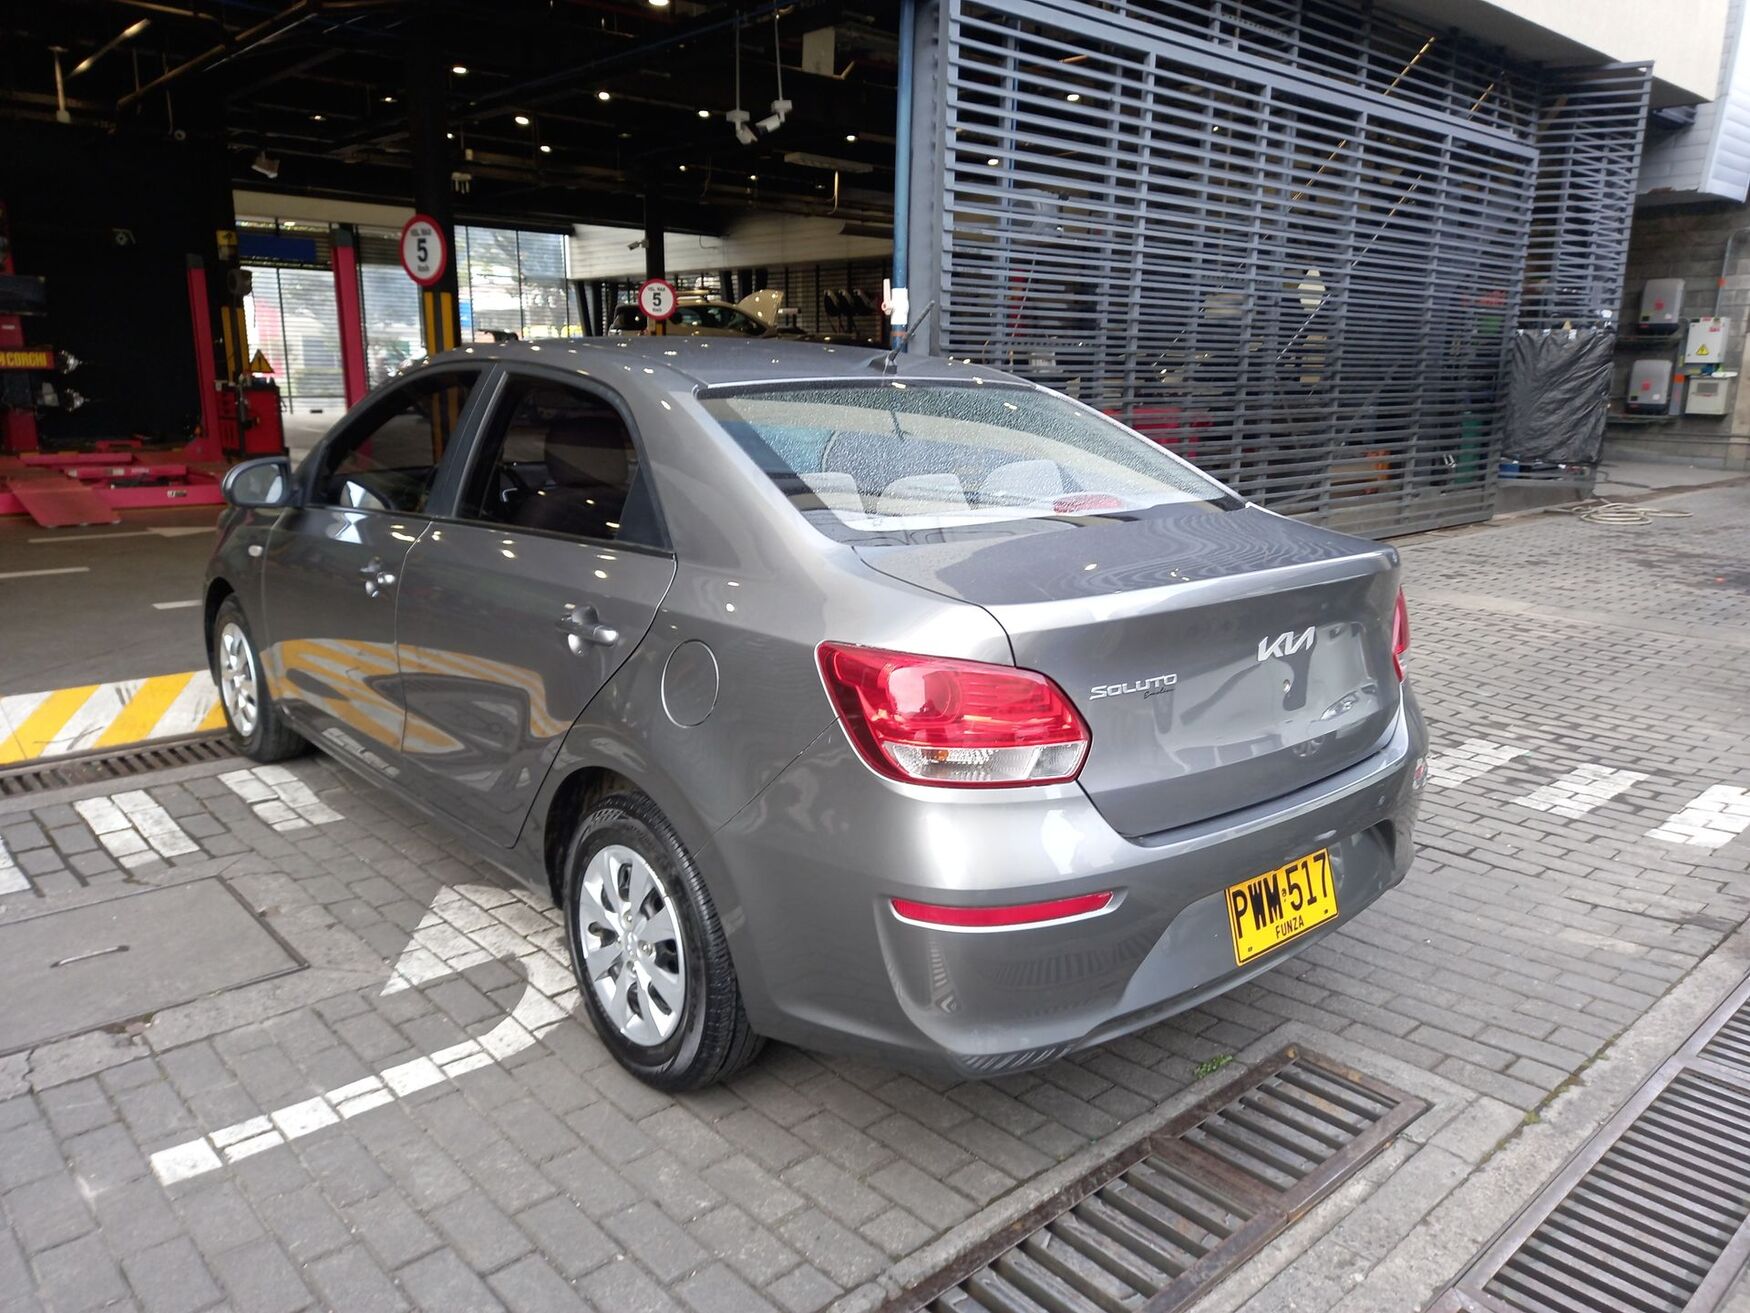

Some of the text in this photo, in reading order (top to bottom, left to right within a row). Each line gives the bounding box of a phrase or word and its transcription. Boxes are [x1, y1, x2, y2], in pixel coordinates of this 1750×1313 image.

[417, 238, 428, 262] 5
[653, 292, 661, 306] 5
[1258, 626, 1315, 661] KIA
[1089, 674, 1177, 700] SOLUTO
[1275, 915, 1304, 939] FUNZA
